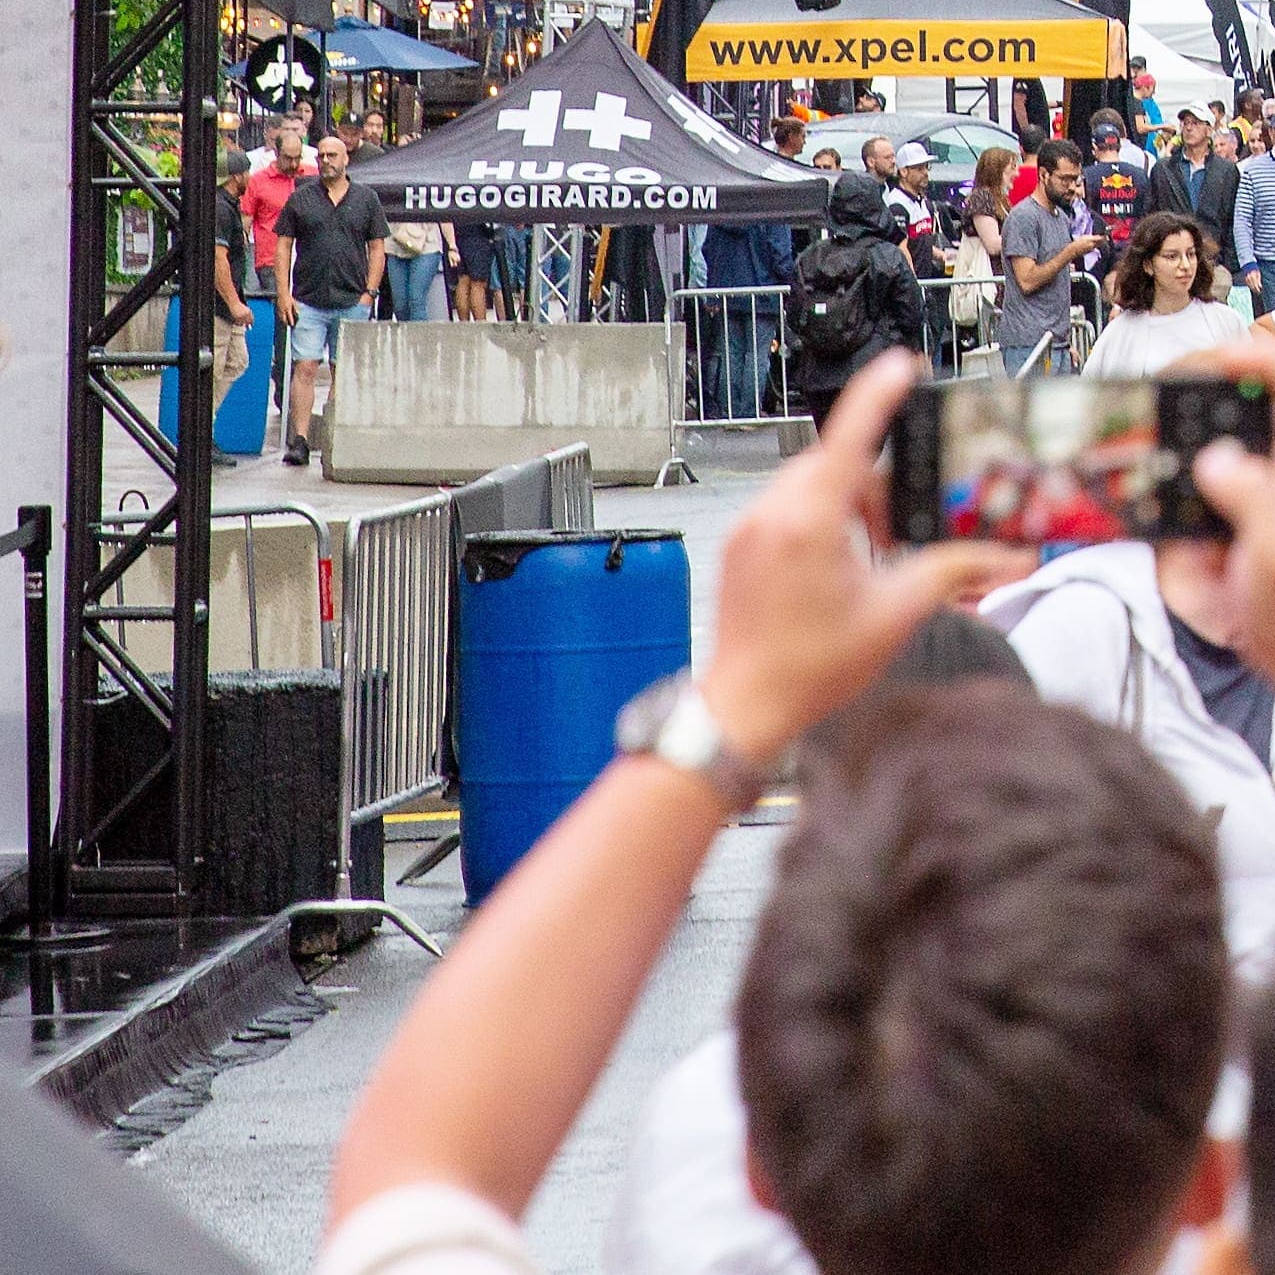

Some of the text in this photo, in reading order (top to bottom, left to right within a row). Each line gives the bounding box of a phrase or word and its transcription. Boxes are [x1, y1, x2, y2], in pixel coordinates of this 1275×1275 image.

[710, 30, 1037, 71] www.xpel.com
[468, 160, 663, 185] HUGO
[404, 183, 718, 211] HUGOGIRARD.COM
